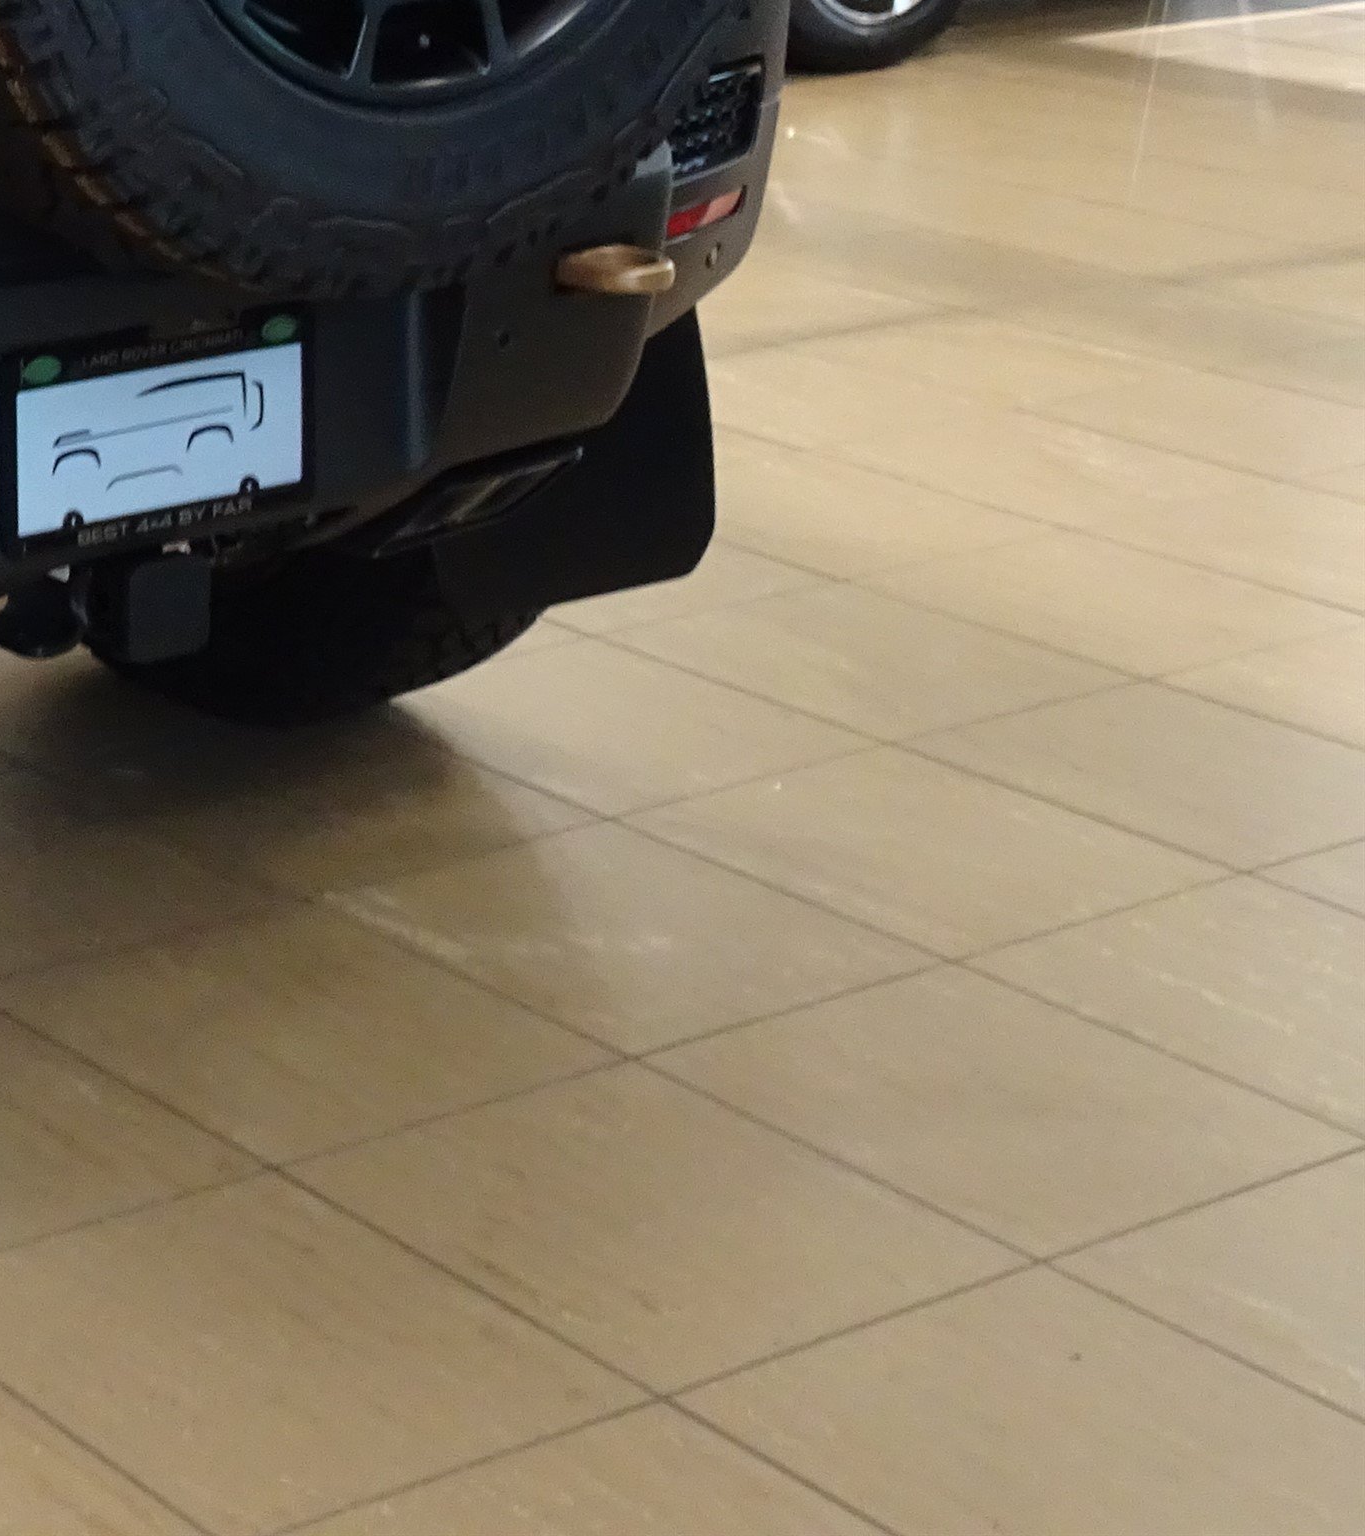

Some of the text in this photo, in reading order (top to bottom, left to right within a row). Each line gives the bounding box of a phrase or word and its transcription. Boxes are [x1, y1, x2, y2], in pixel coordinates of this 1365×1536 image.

[77, 520, 129, 548] BEST
[177, 503, 207, 527] BY
[212, 495, 253, 519] FAR
